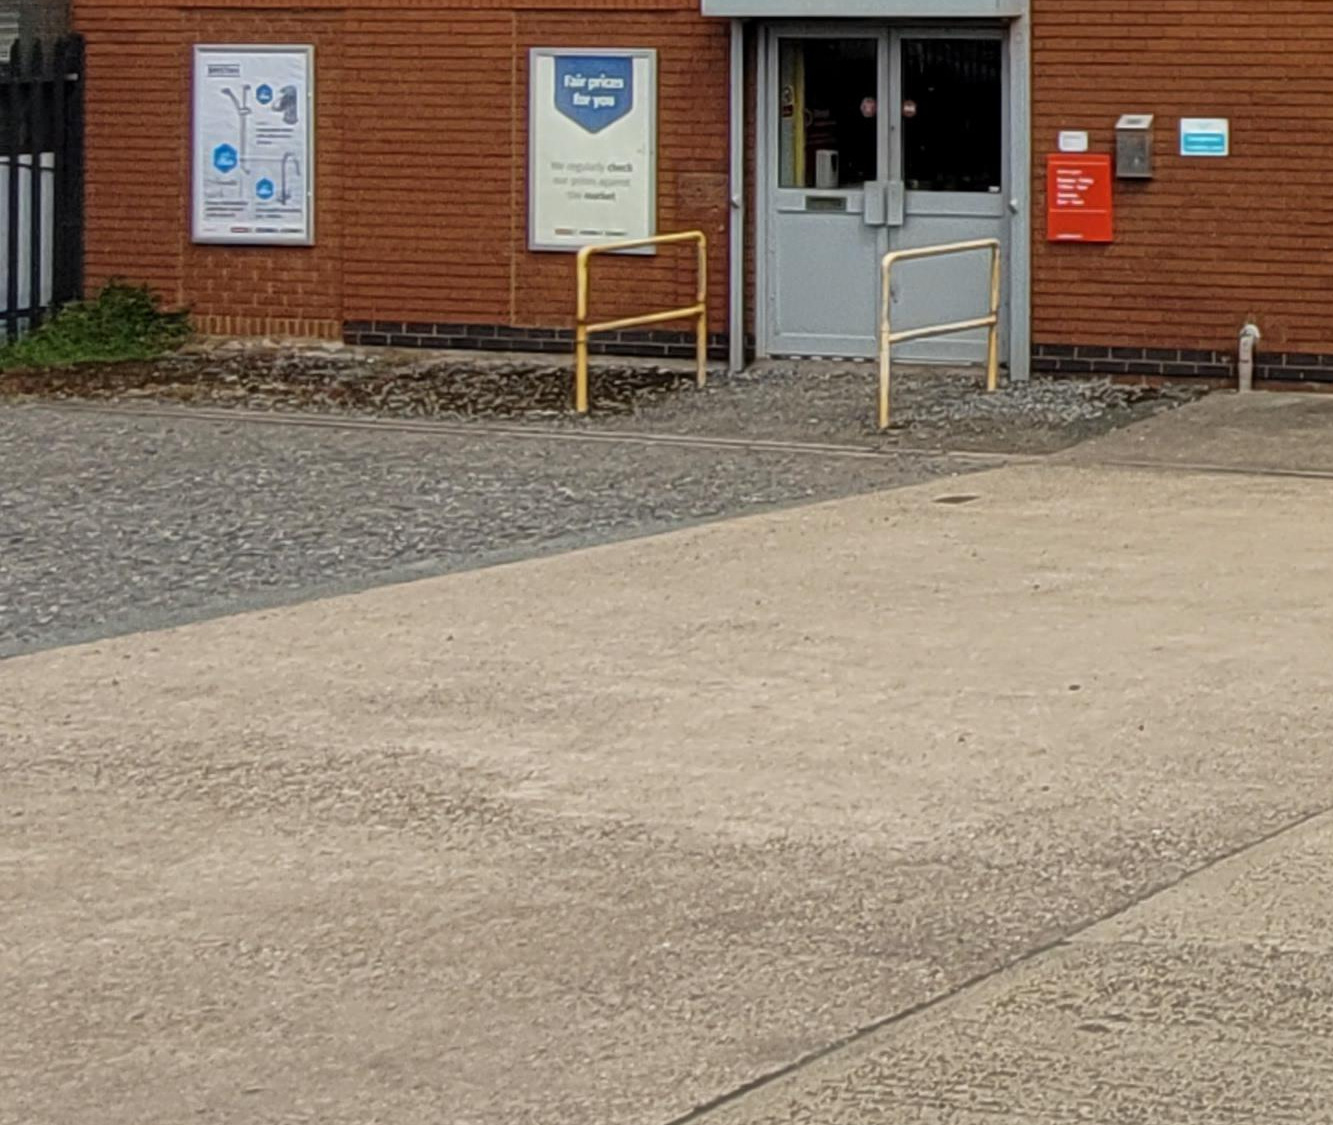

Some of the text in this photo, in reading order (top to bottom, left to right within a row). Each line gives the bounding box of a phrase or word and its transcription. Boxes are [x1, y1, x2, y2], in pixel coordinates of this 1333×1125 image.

[564, 74, 625, 91] Fair prices
[573, 92, 615, 108] for you
